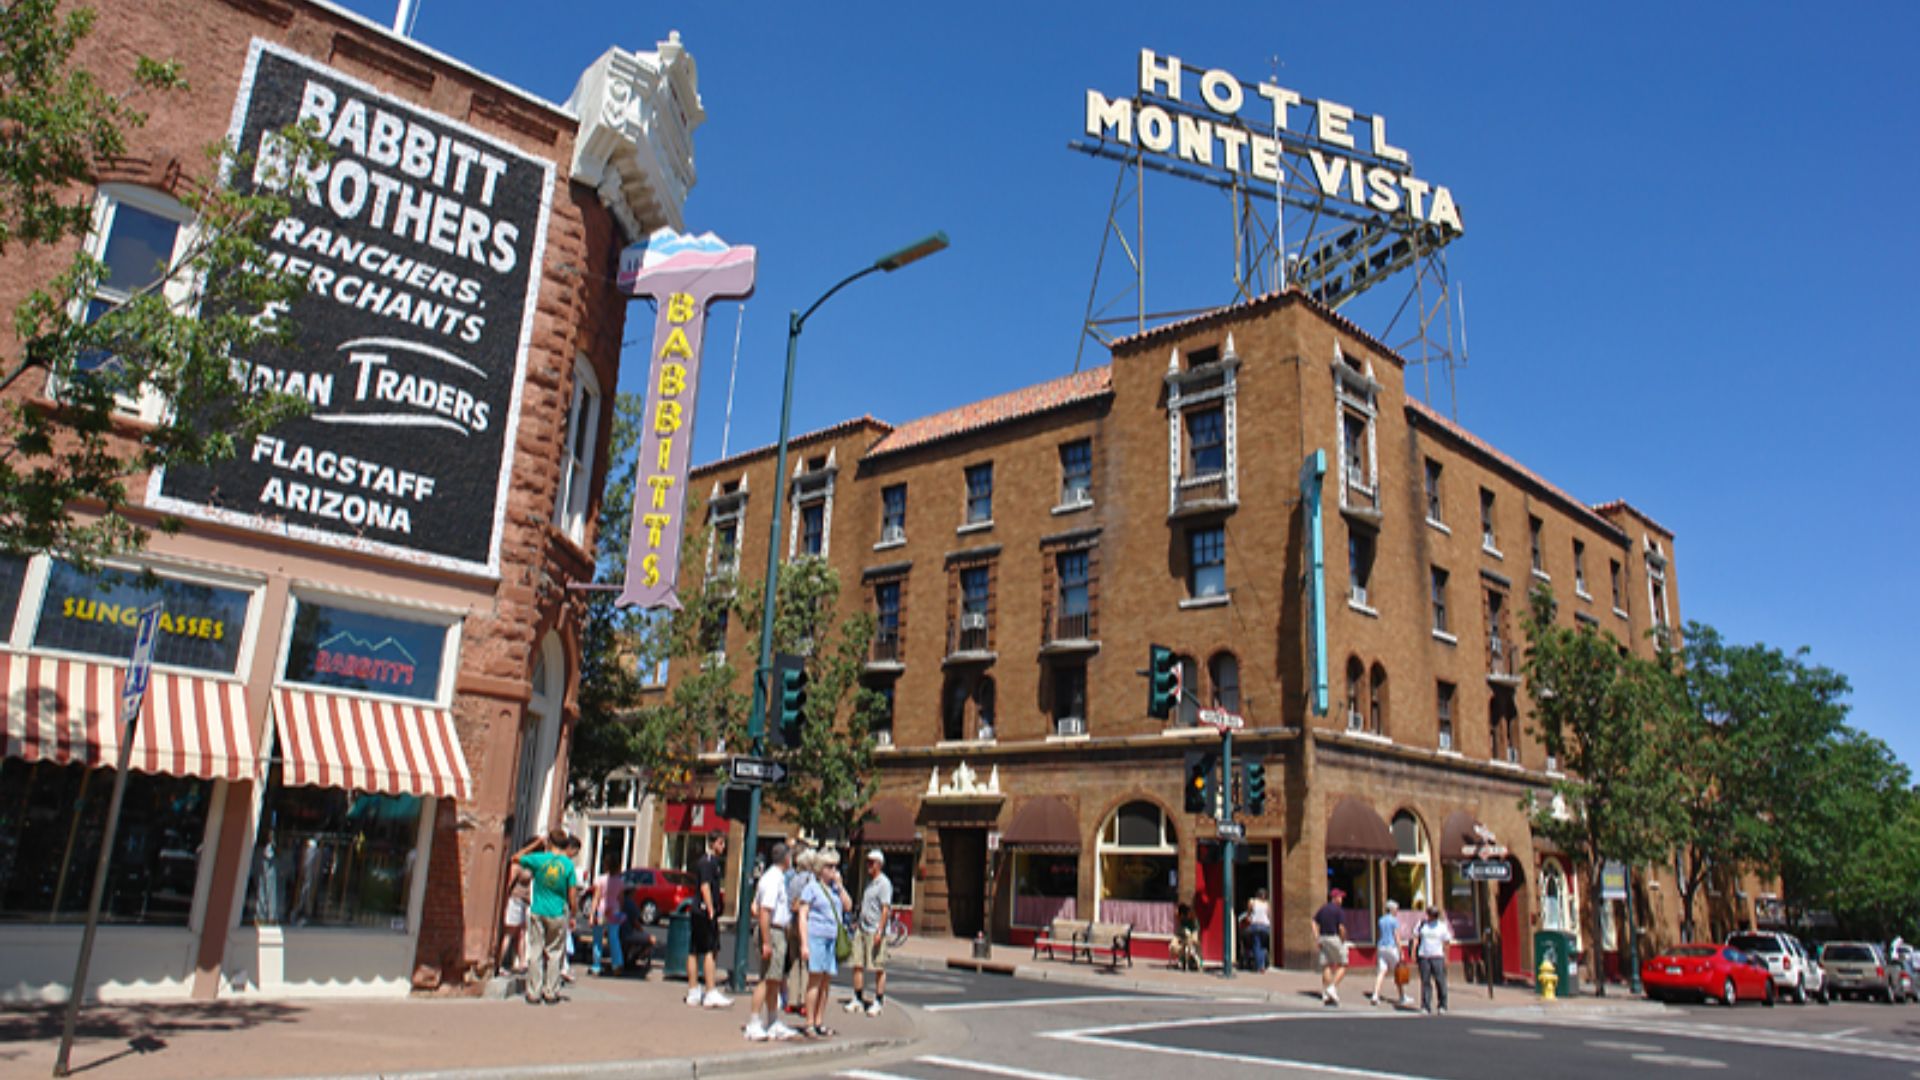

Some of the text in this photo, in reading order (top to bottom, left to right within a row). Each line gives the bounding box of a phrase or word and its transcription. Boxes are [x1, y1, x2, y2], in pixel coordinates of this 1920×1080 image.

[296, 79, 508, 207] BABBITT
[1141, 47, 1408, 163] HOTEL
[252, 128, 520, 274] BROTHERS
[1086, 88, 1464, 232] MONTE VISTA
[350, 351, 491, 432] TRADERS
[251, 434, 436, 502] FLAGSTAFF
[259, 476, 413, 534] ARIZONA
[63, 596, 225, 640] SUNGASSES
